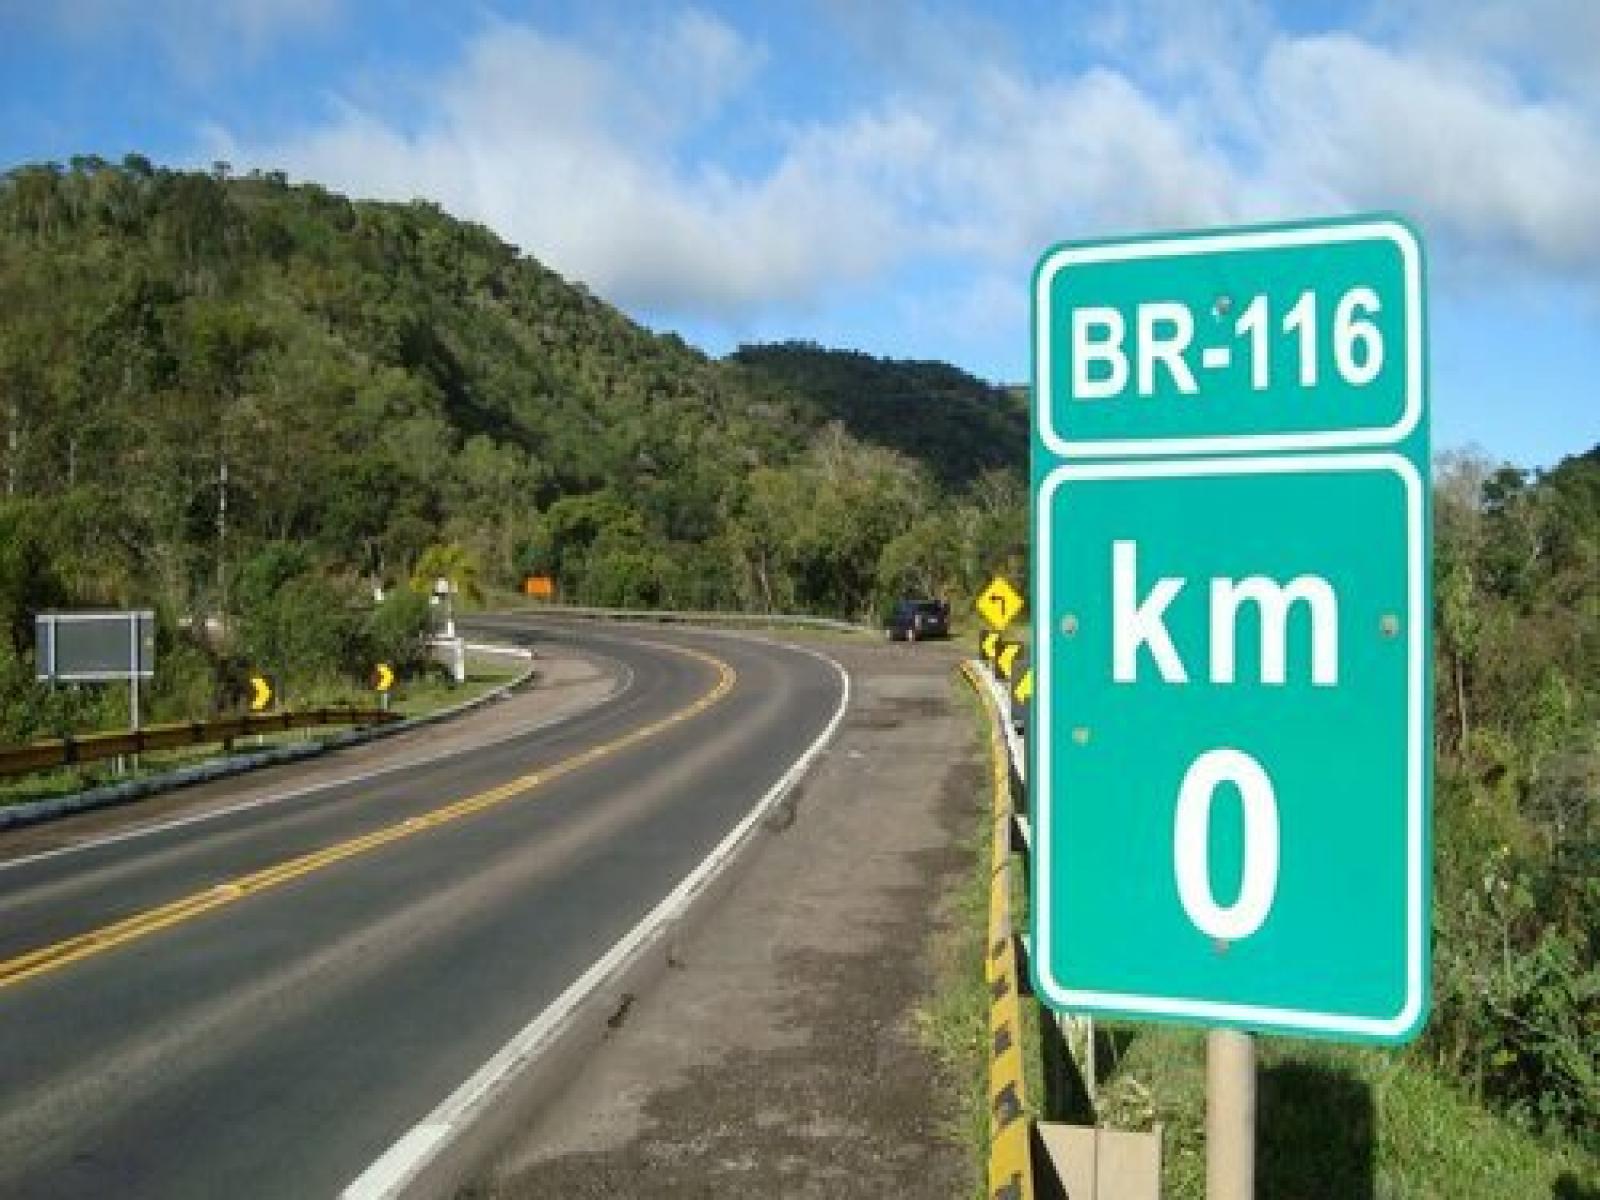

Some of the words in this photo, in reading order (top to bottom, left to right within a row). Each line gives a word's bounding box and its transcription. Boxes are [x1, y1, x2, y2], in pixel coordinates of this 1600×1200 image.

[1070, 287, 1384, 399] BR-116
[1111, 540, 1339, 685] km
[1173, 748, 1279, 942] 0
